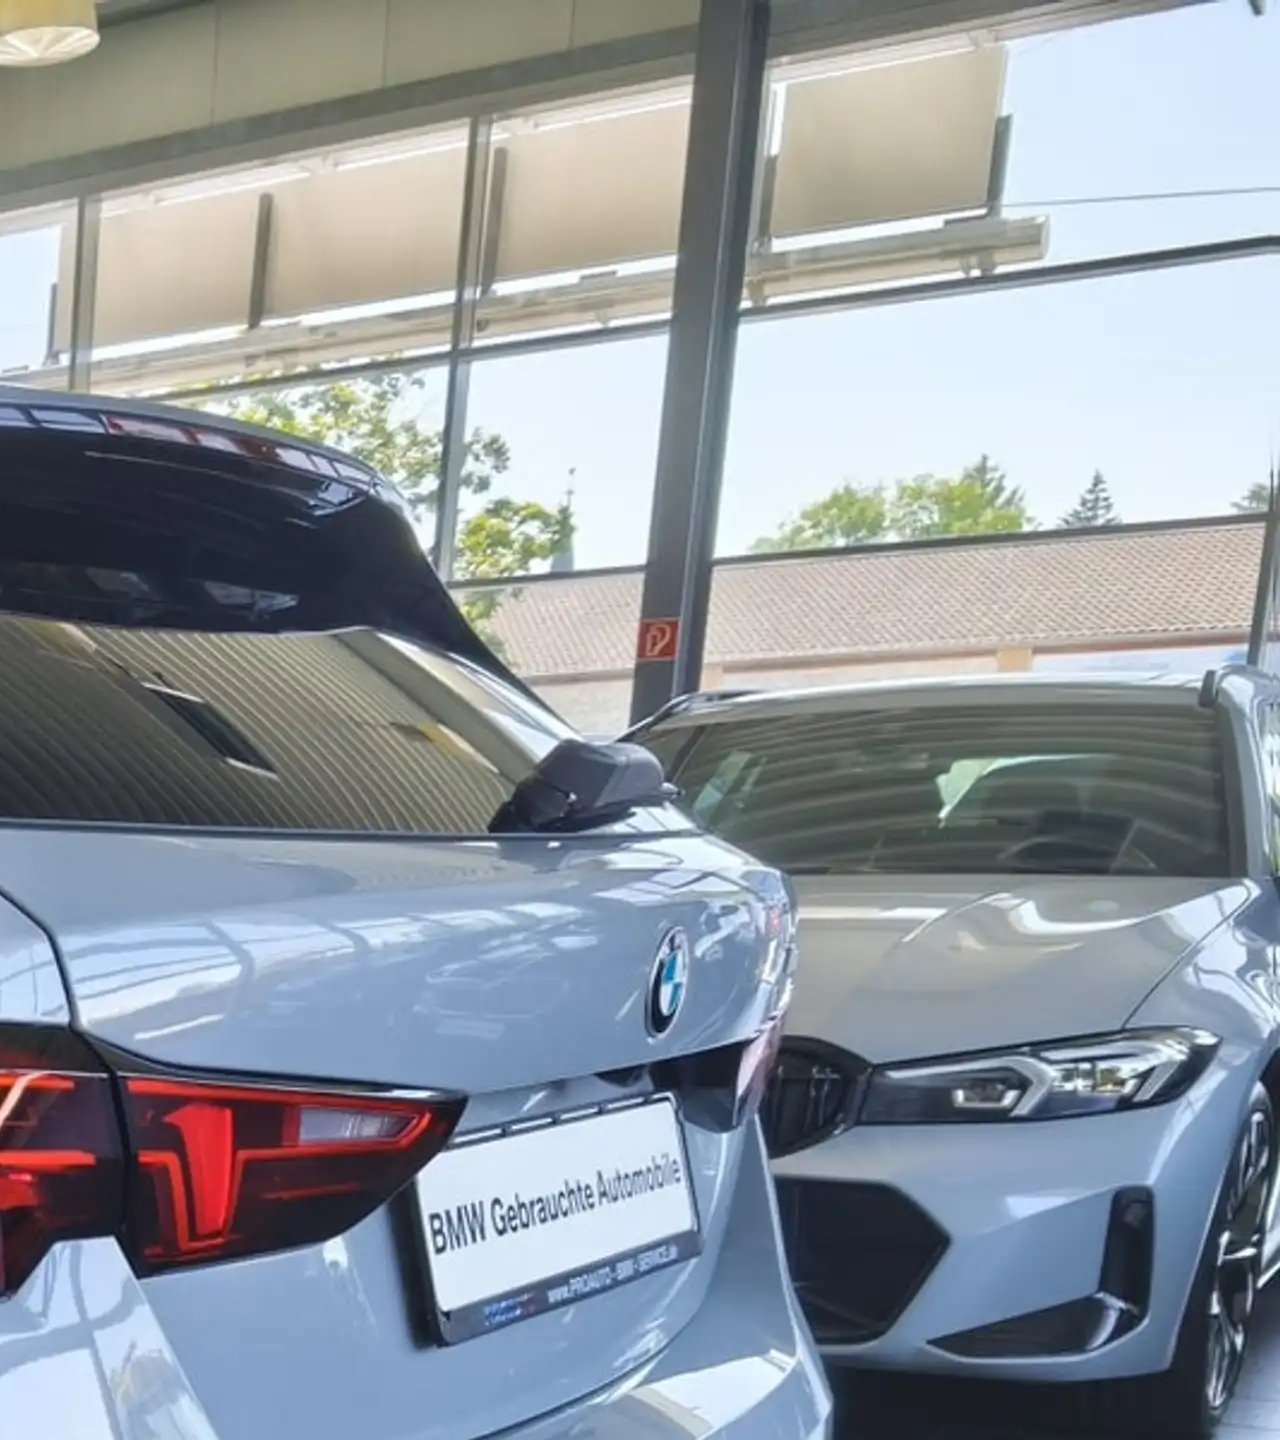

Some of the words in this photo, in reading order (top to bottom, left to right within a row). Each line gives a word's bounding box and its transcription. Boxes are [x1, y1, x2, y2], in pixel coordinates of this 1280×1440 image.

[428, 1200, 487, 1255] BMW
[490, 1180, 595, 1238] Gebrauchte
[597, 1151, 682, 1206] Automobile
